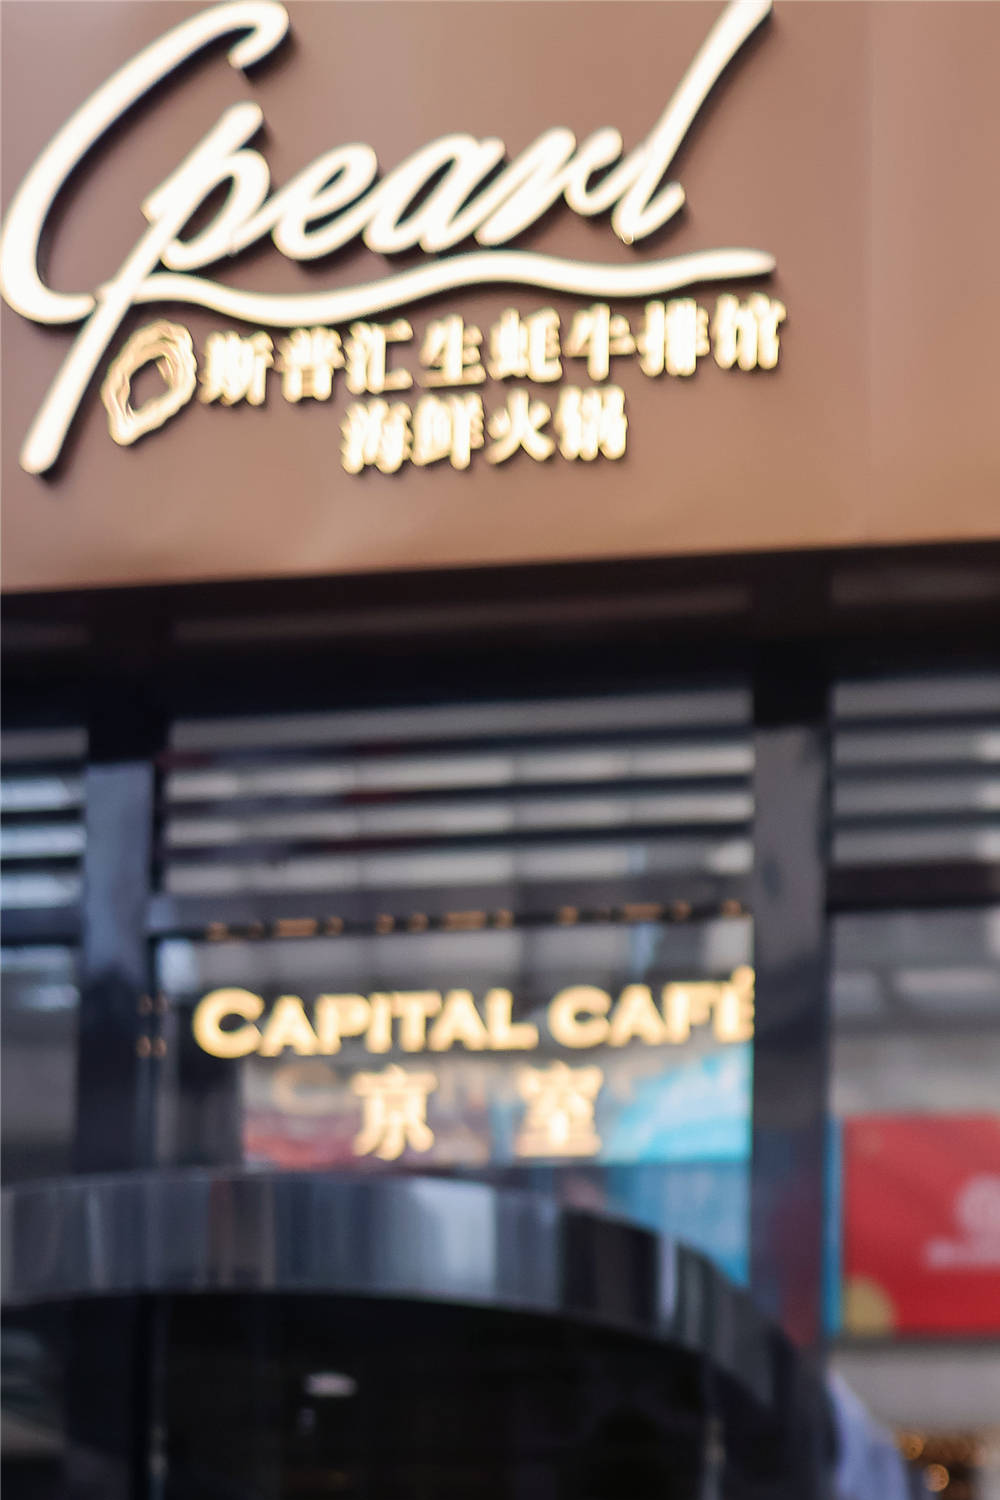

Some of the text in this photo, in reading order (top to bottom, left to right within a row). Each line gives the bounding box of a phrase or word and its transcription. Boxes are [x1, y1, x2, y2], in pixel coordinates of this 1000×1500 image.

[0, 0, 776, 475] Cpearl
[341, 384, 628, 474] 海鲜火锅
[194, 966, 755, 1058] CAPITAL CAFÉ
